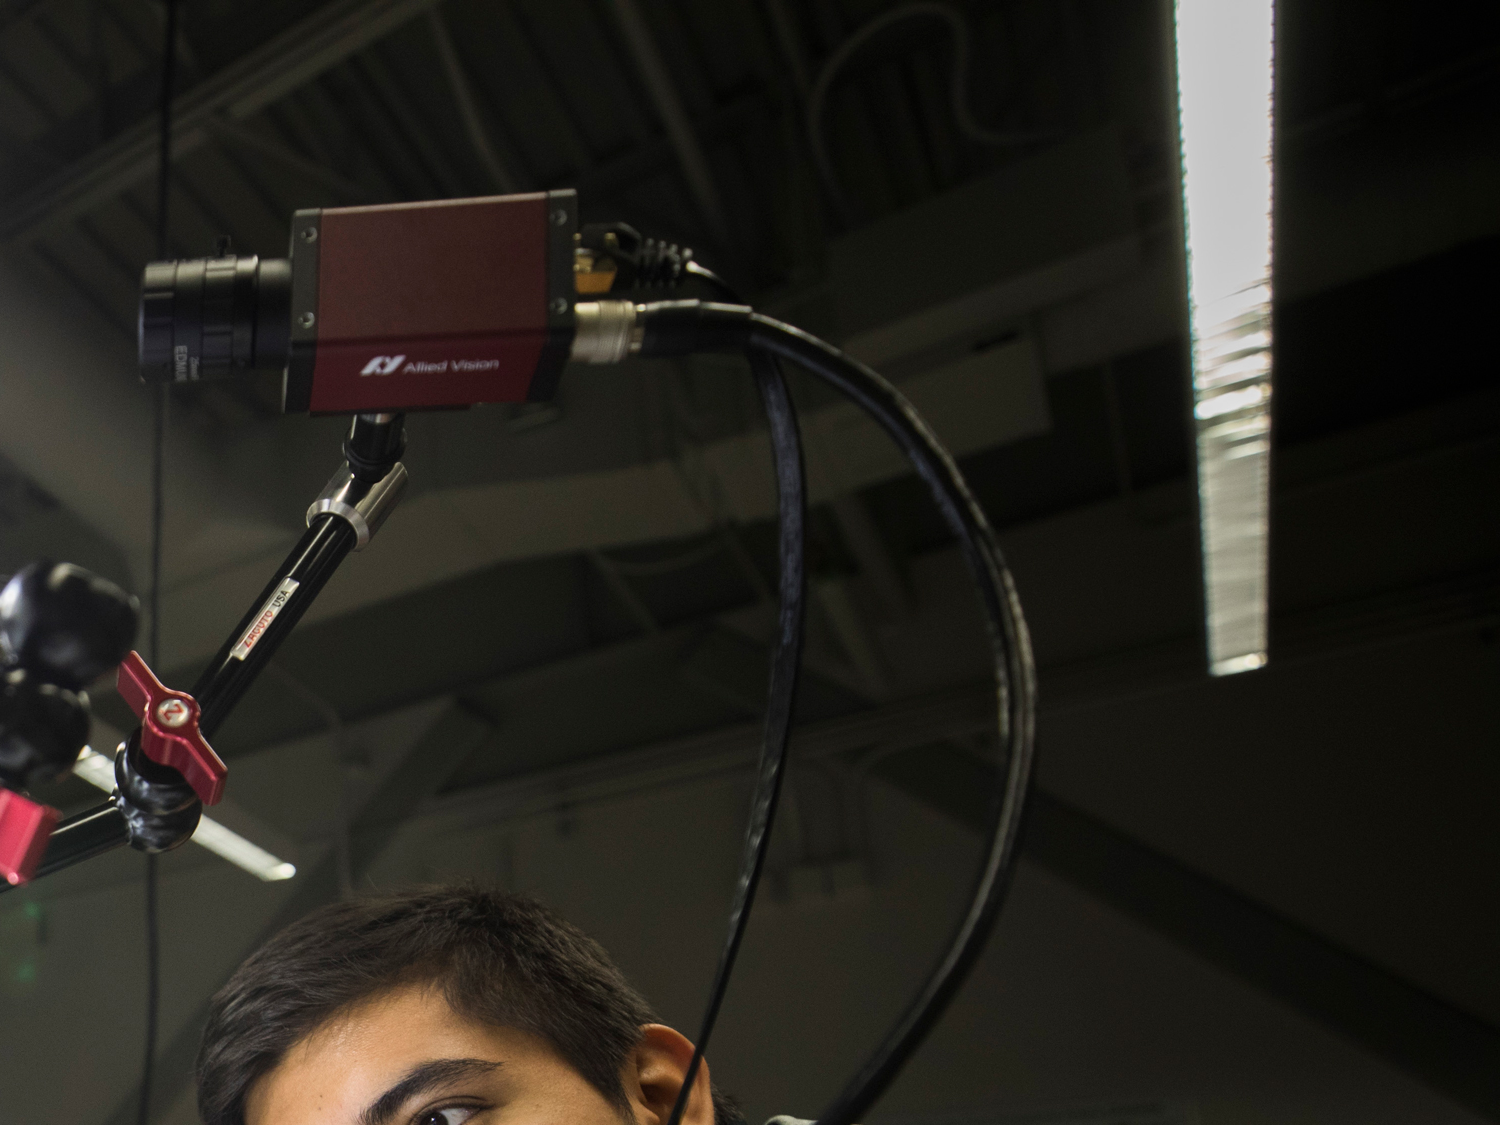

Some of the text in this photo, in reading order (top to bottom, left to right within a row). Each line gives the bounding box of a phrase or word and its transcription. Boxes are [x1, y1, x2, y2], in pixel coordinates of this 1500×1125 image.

[402, 359, 448, 375] Allied
[449, 358, 500, 373] Vision
[272, 589, 290, 608] USA
